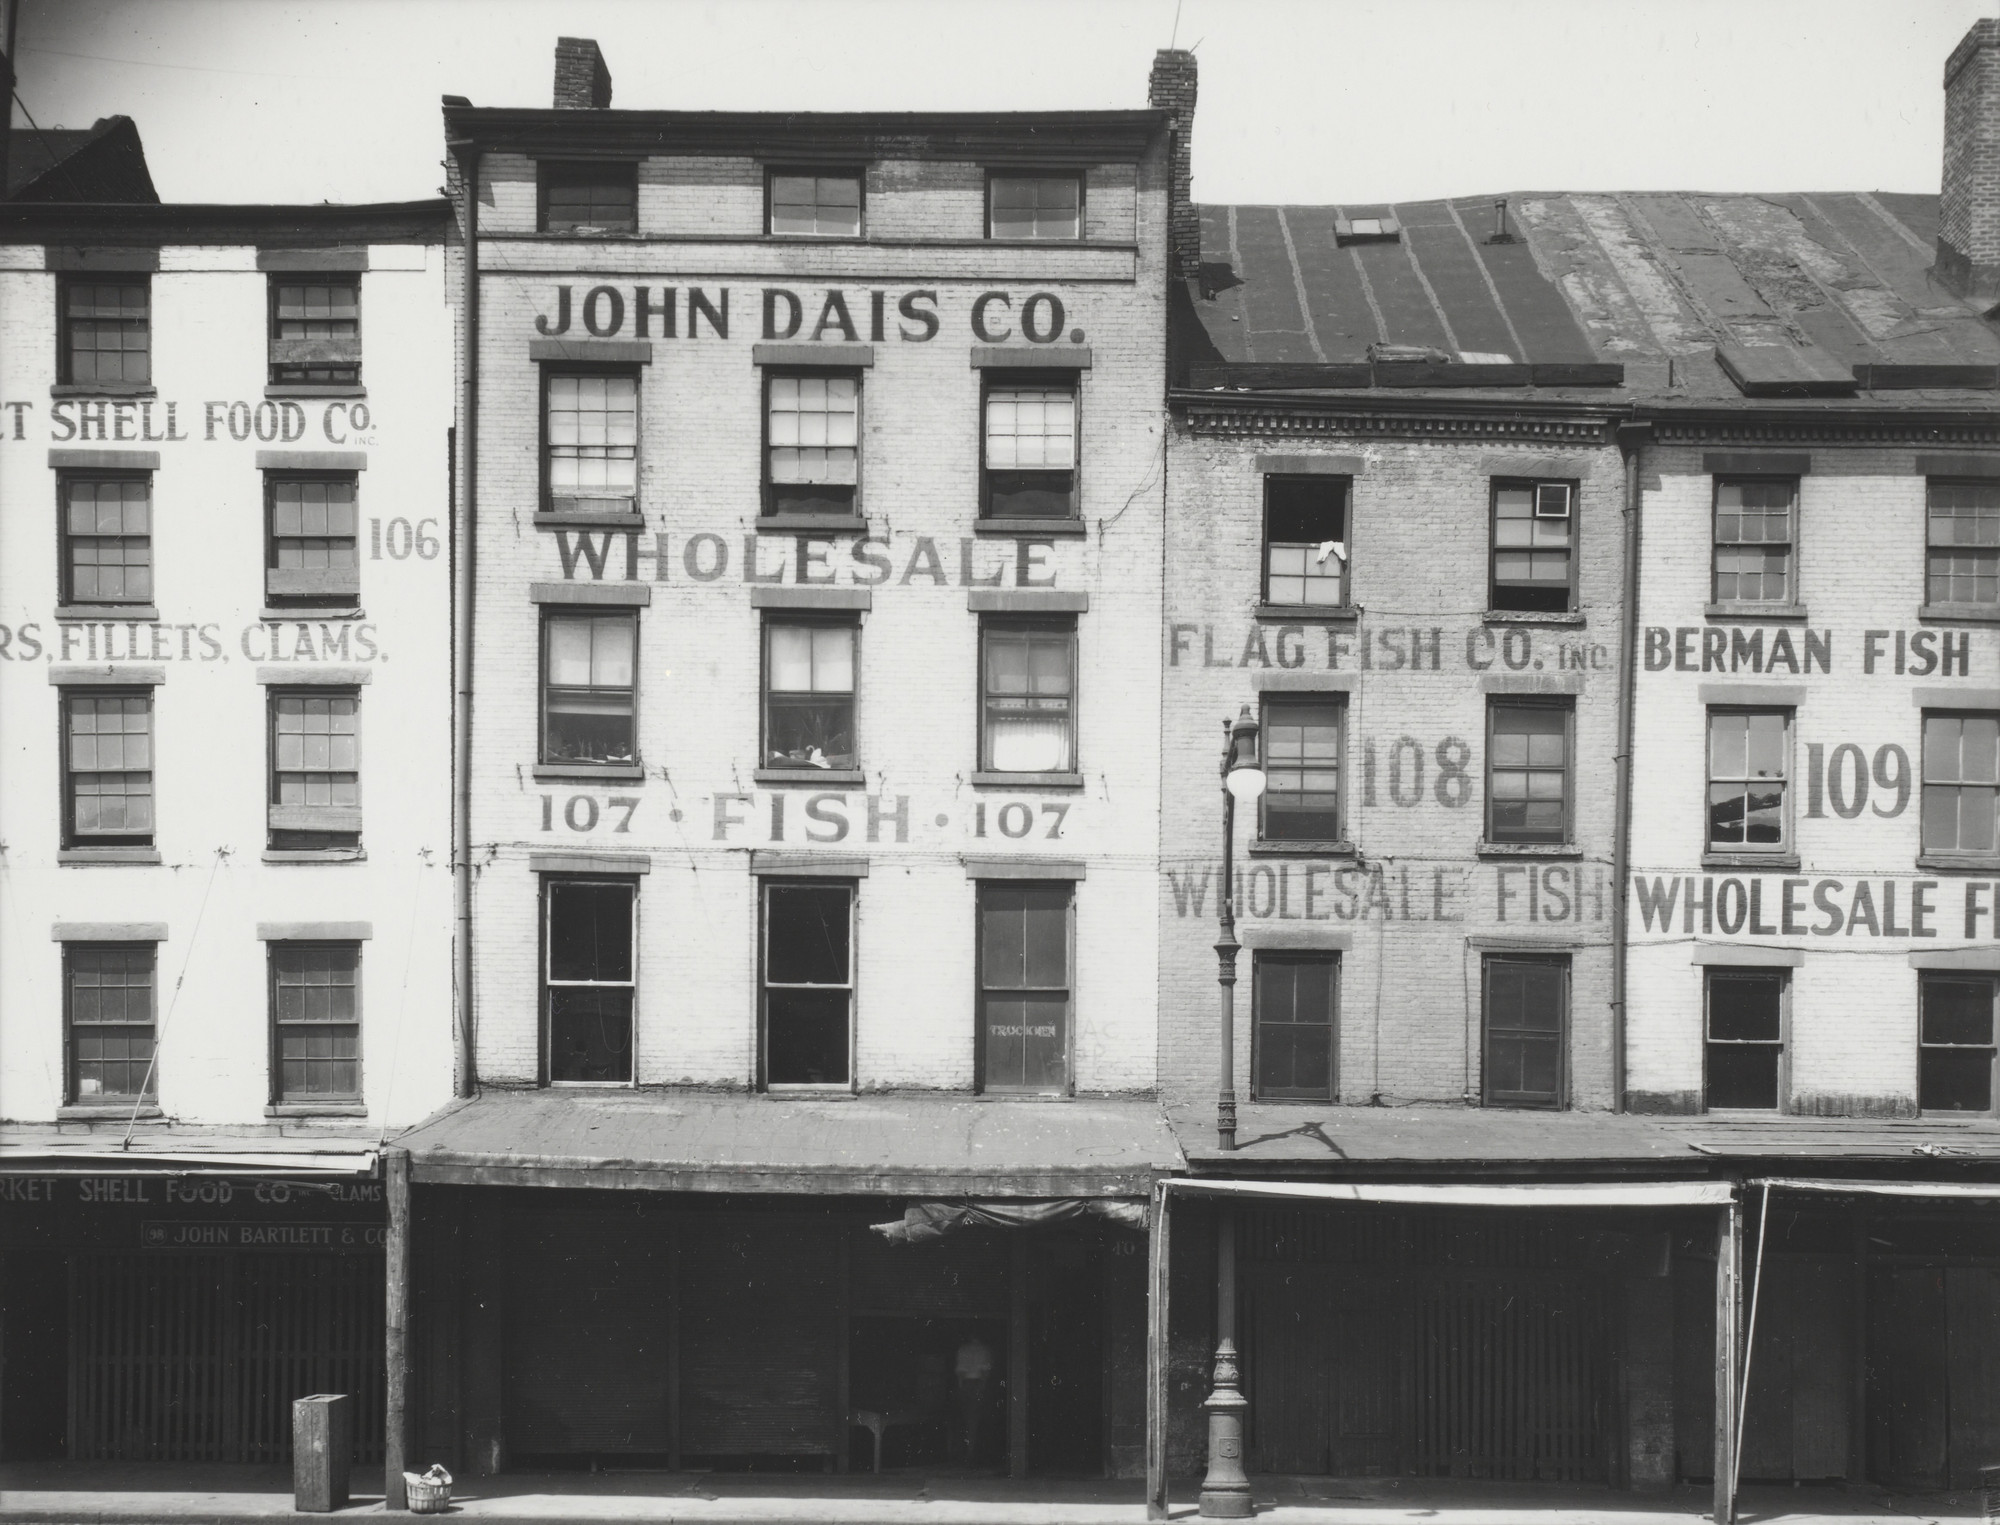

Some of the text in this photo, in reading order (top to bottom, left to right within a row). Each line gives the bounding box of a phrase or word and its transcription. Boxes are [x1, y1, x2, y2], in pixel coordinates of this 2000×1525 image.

[534, 285, 1085, 344] JOHN DAIS CO.
[0, 401, 33, 441] T
[50, 401, 189, 442] SHELL
[204, 401, 306, 442] FOOD
[368, 517, 440, 560] 106
[553, 532, 1057, 588] WHOLESALE
[59, 623, 229, 664] FILLETS,
[240, 623, 389, 663] CLAMS.
[1169, 623, 1304, 668] FLAG
[1325, 627, 1441, 671] FISH
[1466, 628, 1544, 671] CO.
[1644, 626, 1969, 677] BERMAN FISH
[1363, 735, 1473, 808] 108
[1803, 743, 1911, 819] 109
[540, 792, 1072, 844] 107 FISH 107
[1168, 863, 1603, 922] WHOLESALE FISH
[1634, 876, 1938, 938] WHOLESALE
[79, 1179, 150, 1202] SHELL
[166, 1180, 232, 1203] FOOD
[174, 1227, 229, 1243] JOHN
[240, 1227, 333, 1243] BARTLETT
[341, 1228, 355, 1244] &
